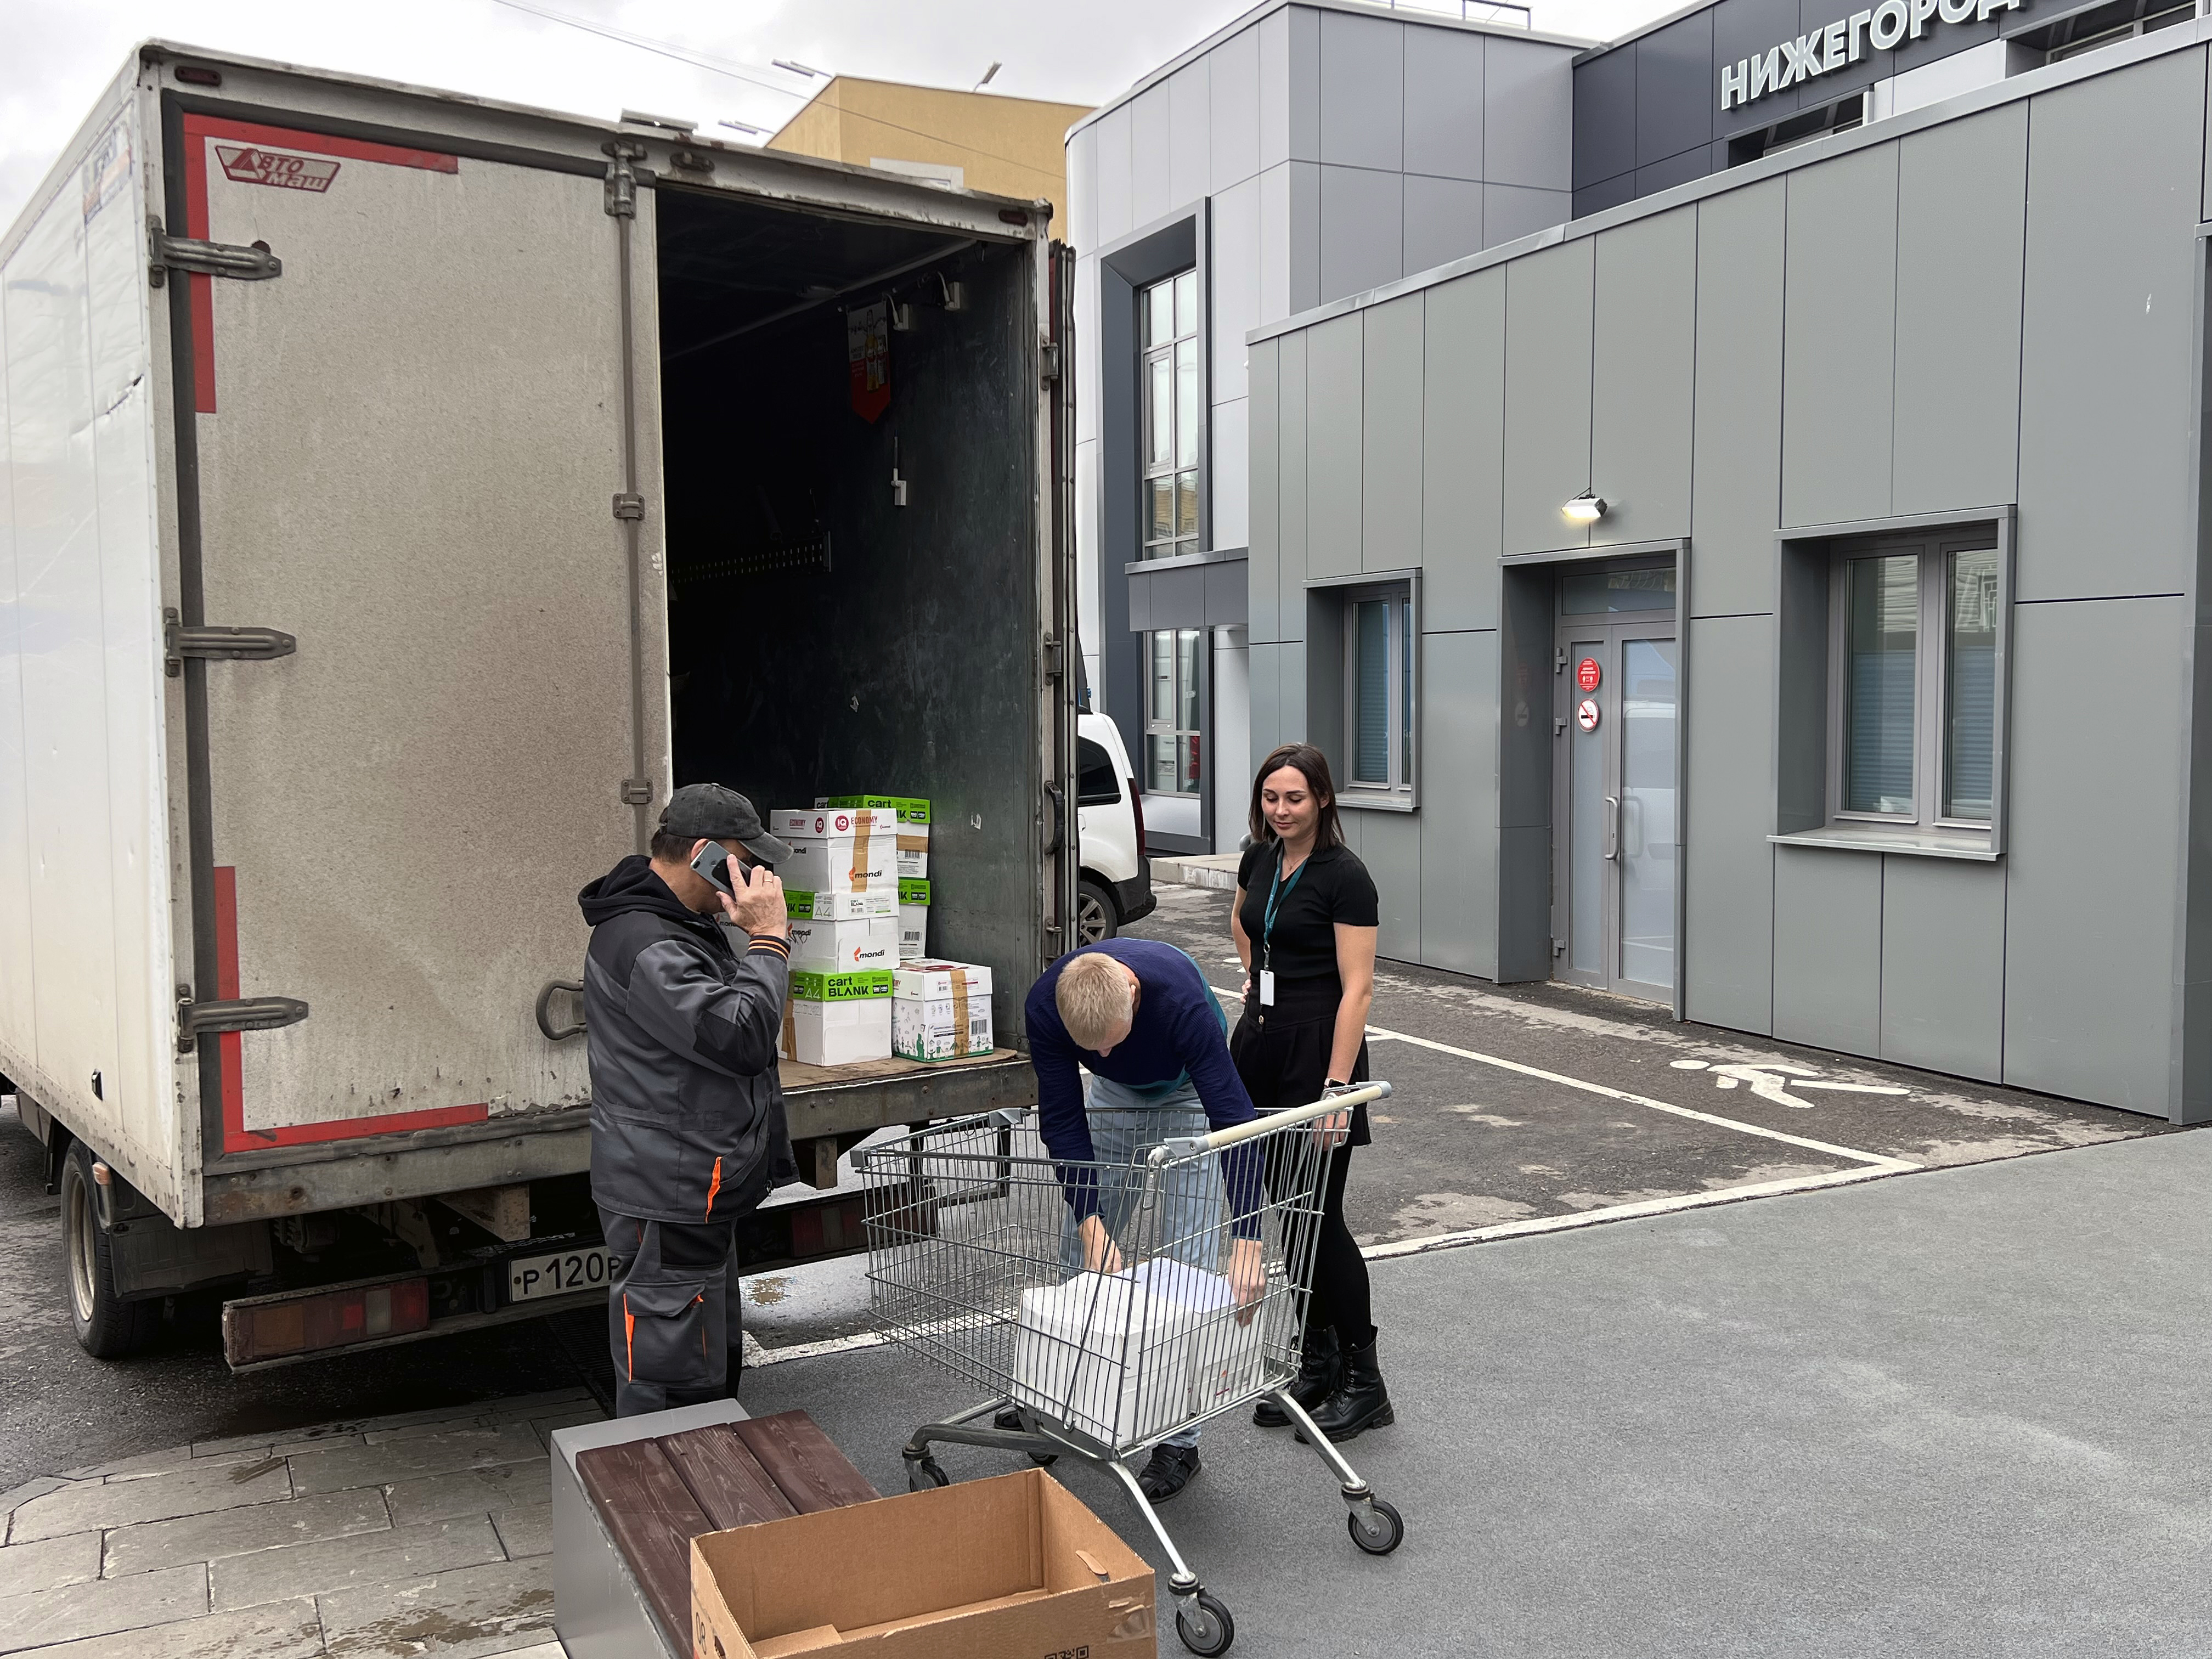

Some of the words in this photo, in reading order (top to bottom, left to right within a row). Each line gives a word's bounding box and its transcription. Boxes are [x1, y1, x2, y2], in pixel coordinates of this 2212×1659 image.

[867, 799, 891, 808] cart
[837, 818, 847, 827] IQ
[850, 816, 878, 825] ECONOMY
[854, 870, 883, 879] mondi
[815, 906, 832, 917] A4
[859, 949, 885, 958] mondi
[828, 976, 853, 987] cart
[805, 988, 821, 1000] A4
[828, 985, 869, 997] BLANK
